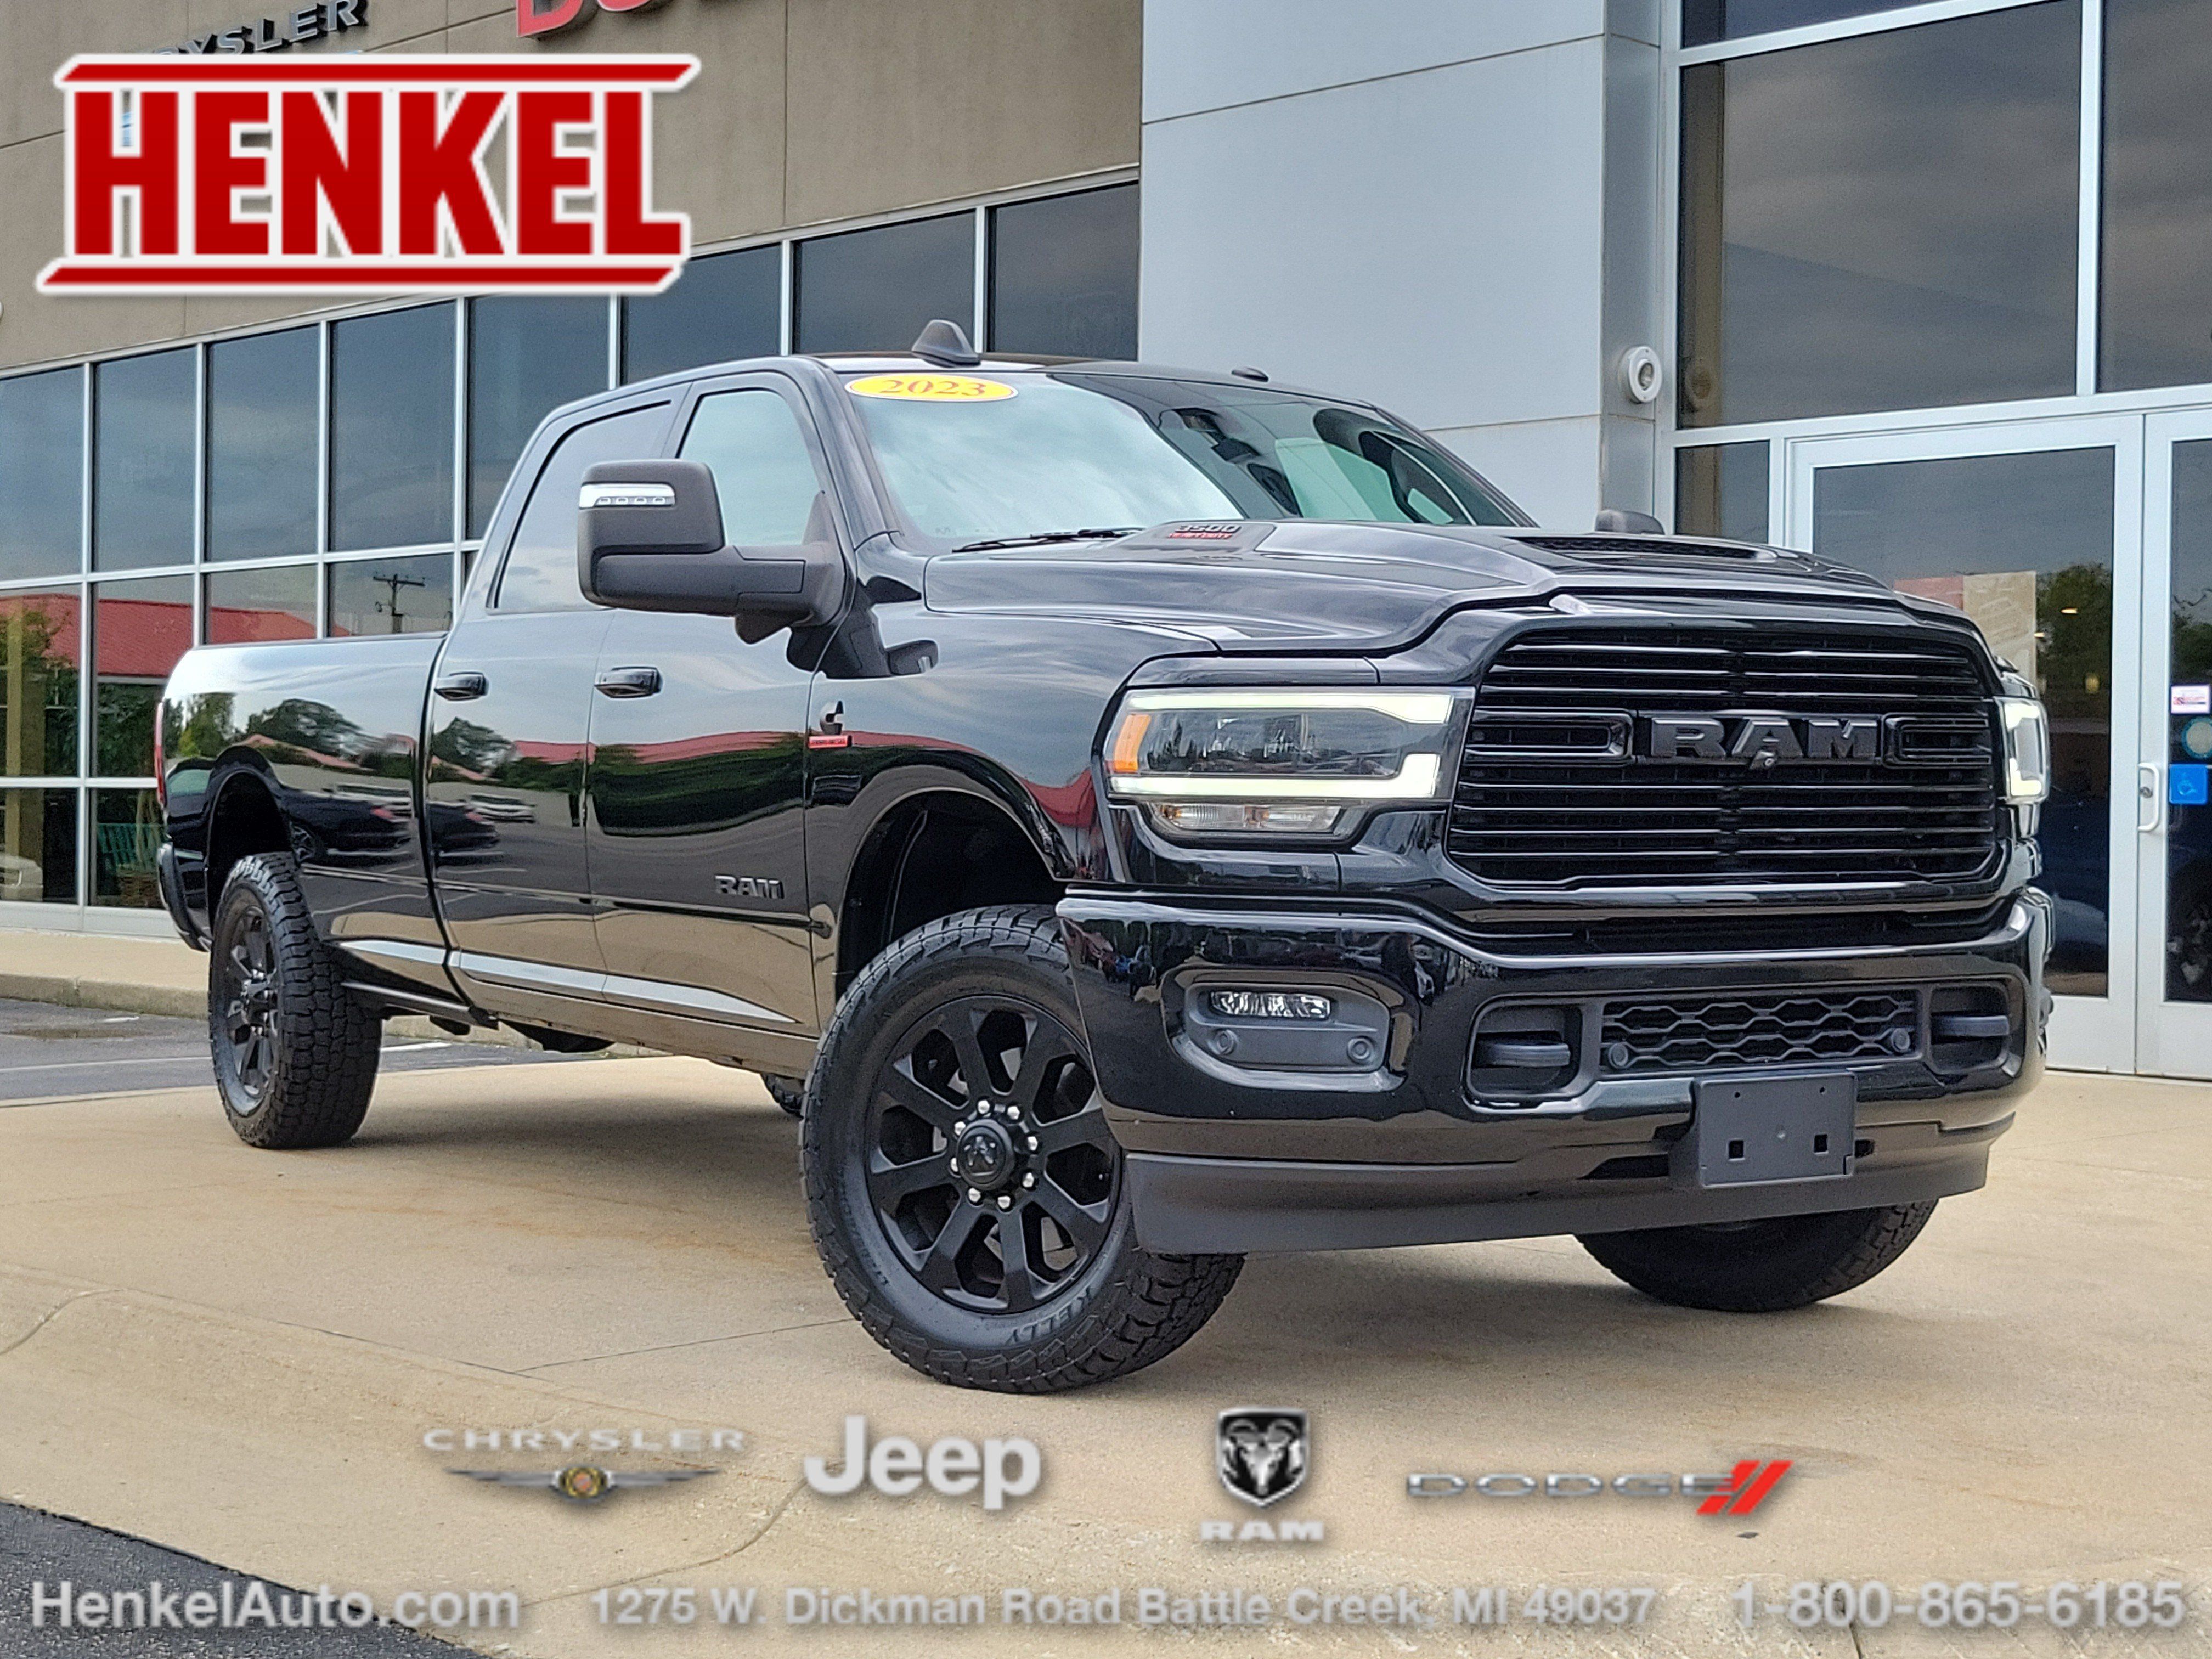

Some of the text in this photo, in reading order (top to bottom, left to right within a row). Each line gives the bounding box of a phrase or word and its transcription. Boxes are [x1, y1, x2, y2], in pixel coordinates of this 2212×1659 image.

[879, 379, 986, 396] 2023
[1175, 524, 1242, 533] 3500
[1650, 715, 1878, 759] RAM
[714, 874, 785, 899] RAM
